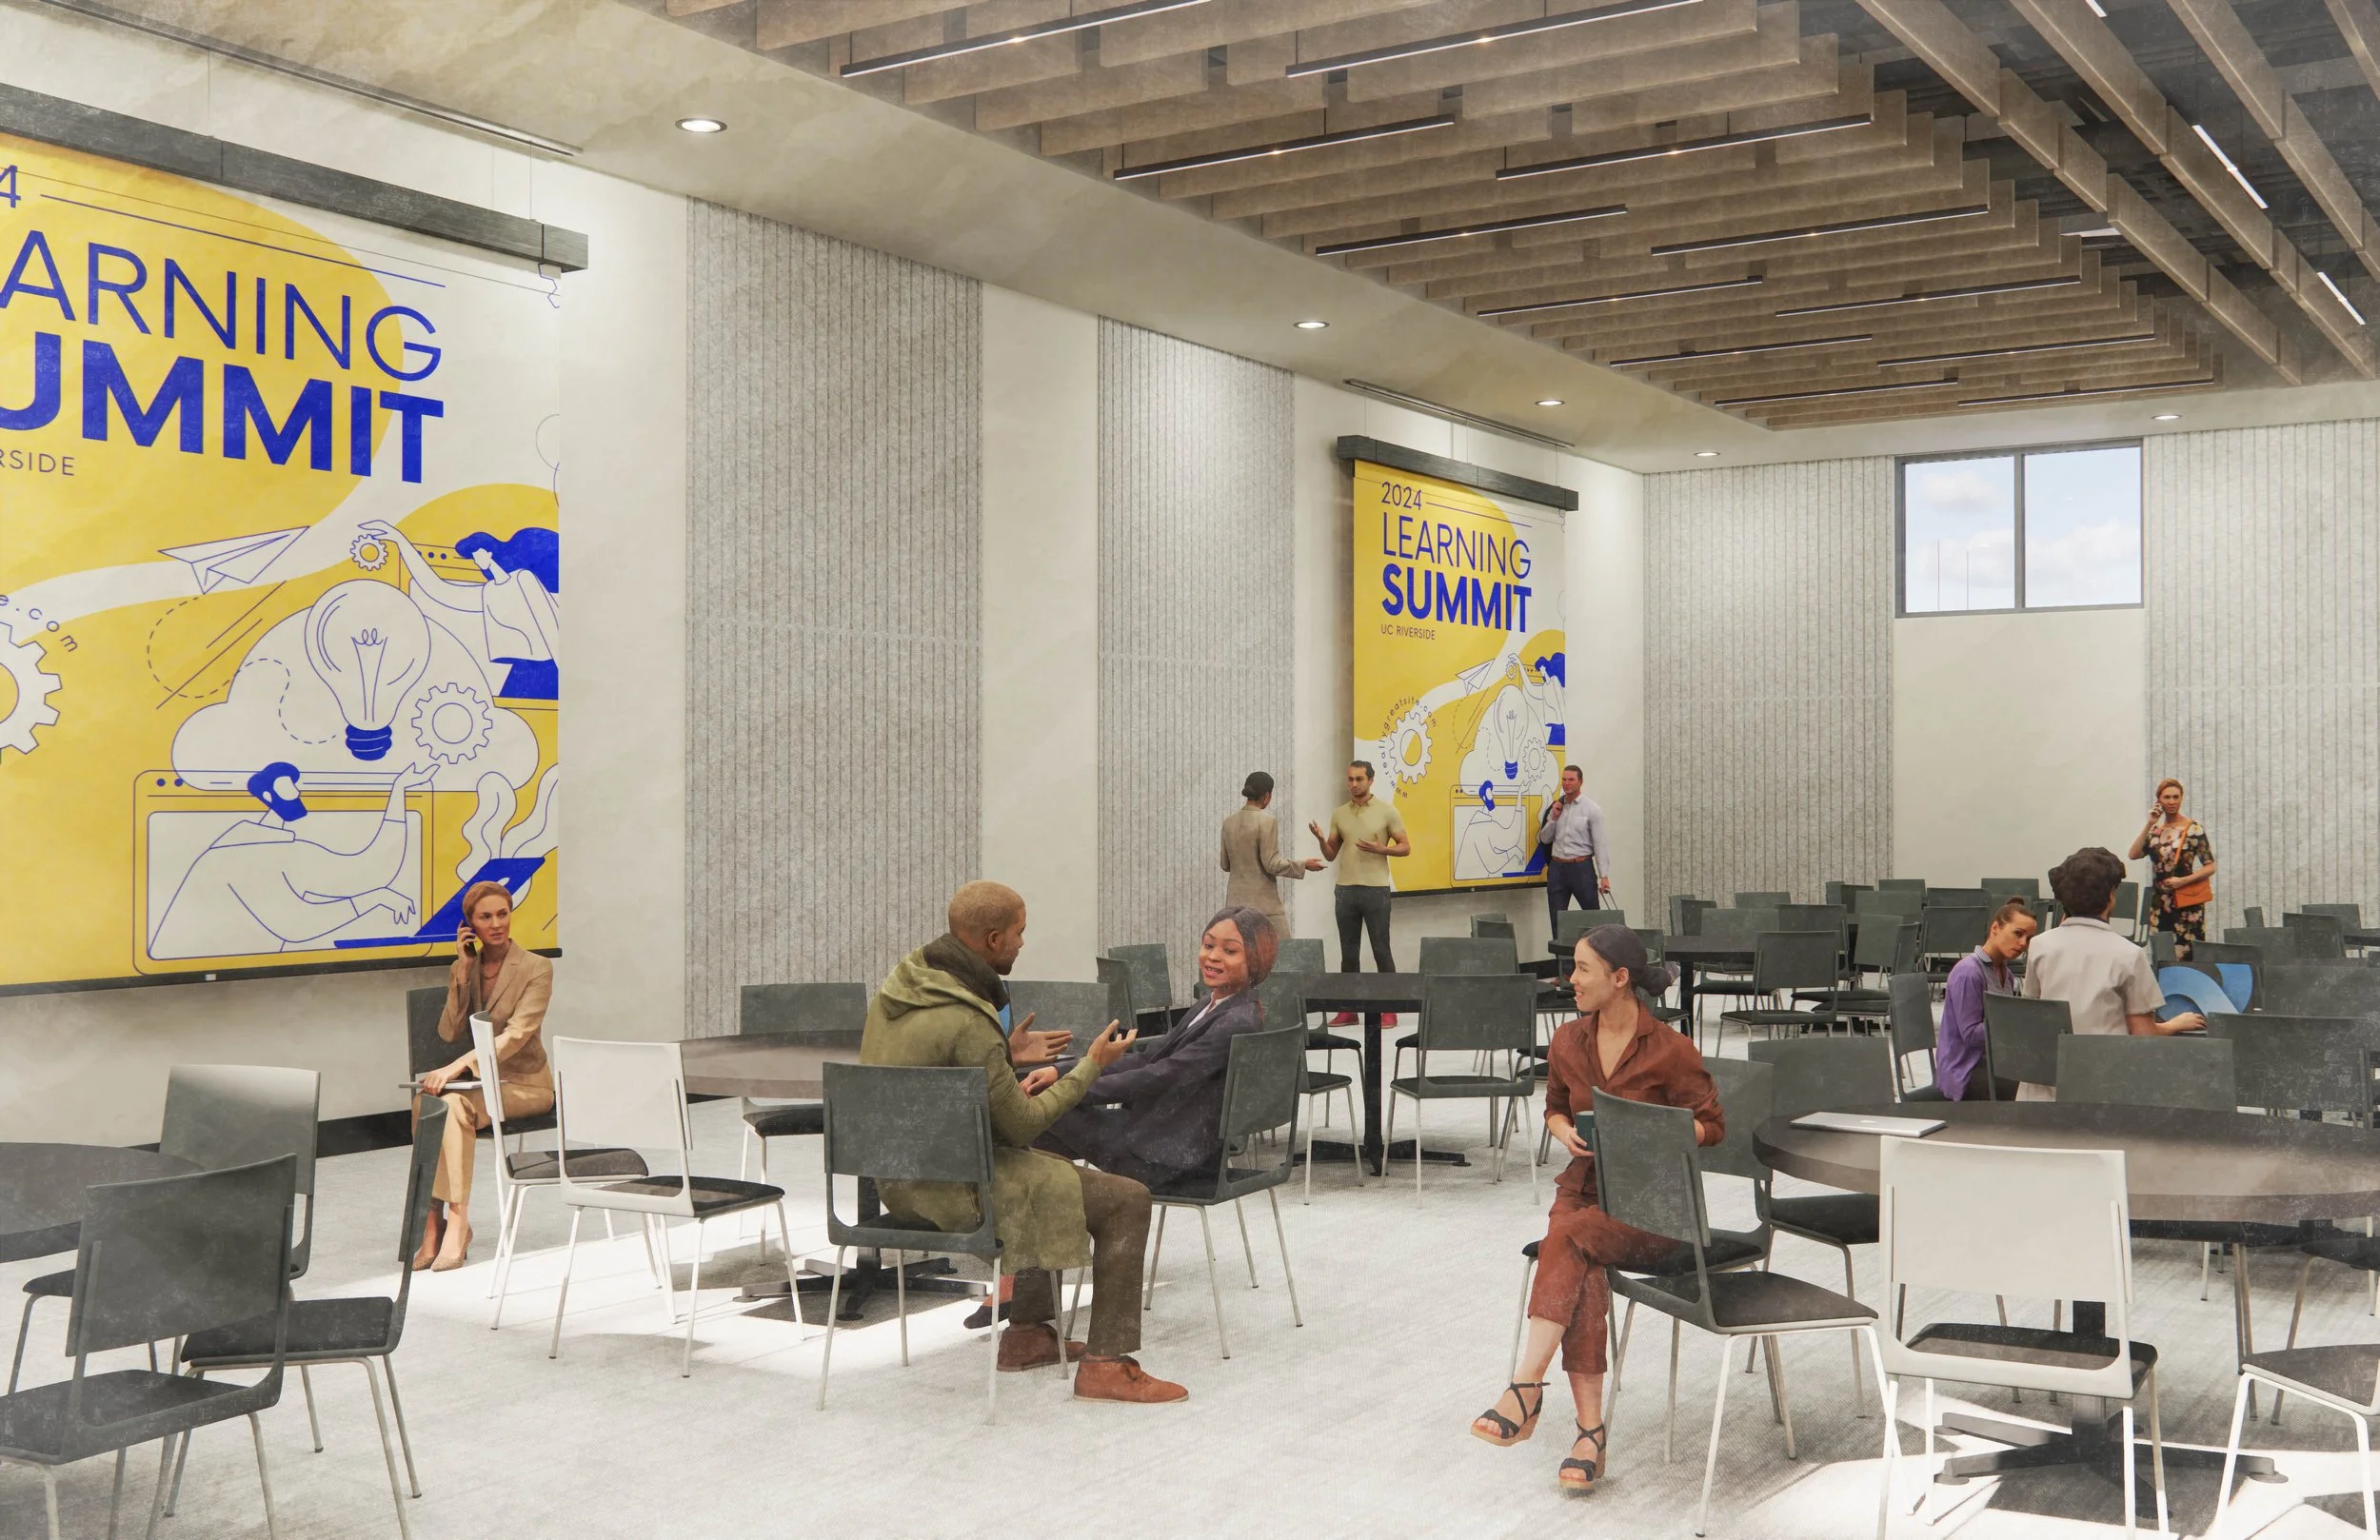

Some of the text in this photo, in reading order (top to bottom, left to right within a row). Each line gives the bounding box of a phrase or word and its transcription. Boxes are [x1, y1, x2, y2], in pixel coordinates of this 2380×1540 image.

[0, 229, 442, 382] ARNING
[1380, 481, 1422, 510] 2024
[1383, 511, 1532, 580] LEARNING
[1380, 623, 1436, 641] UC RIVERSIDE
[1381, 563, 1532, 633] SUMMIT
[1378, 697, 1437, 799] www.reallygreatsite.com
